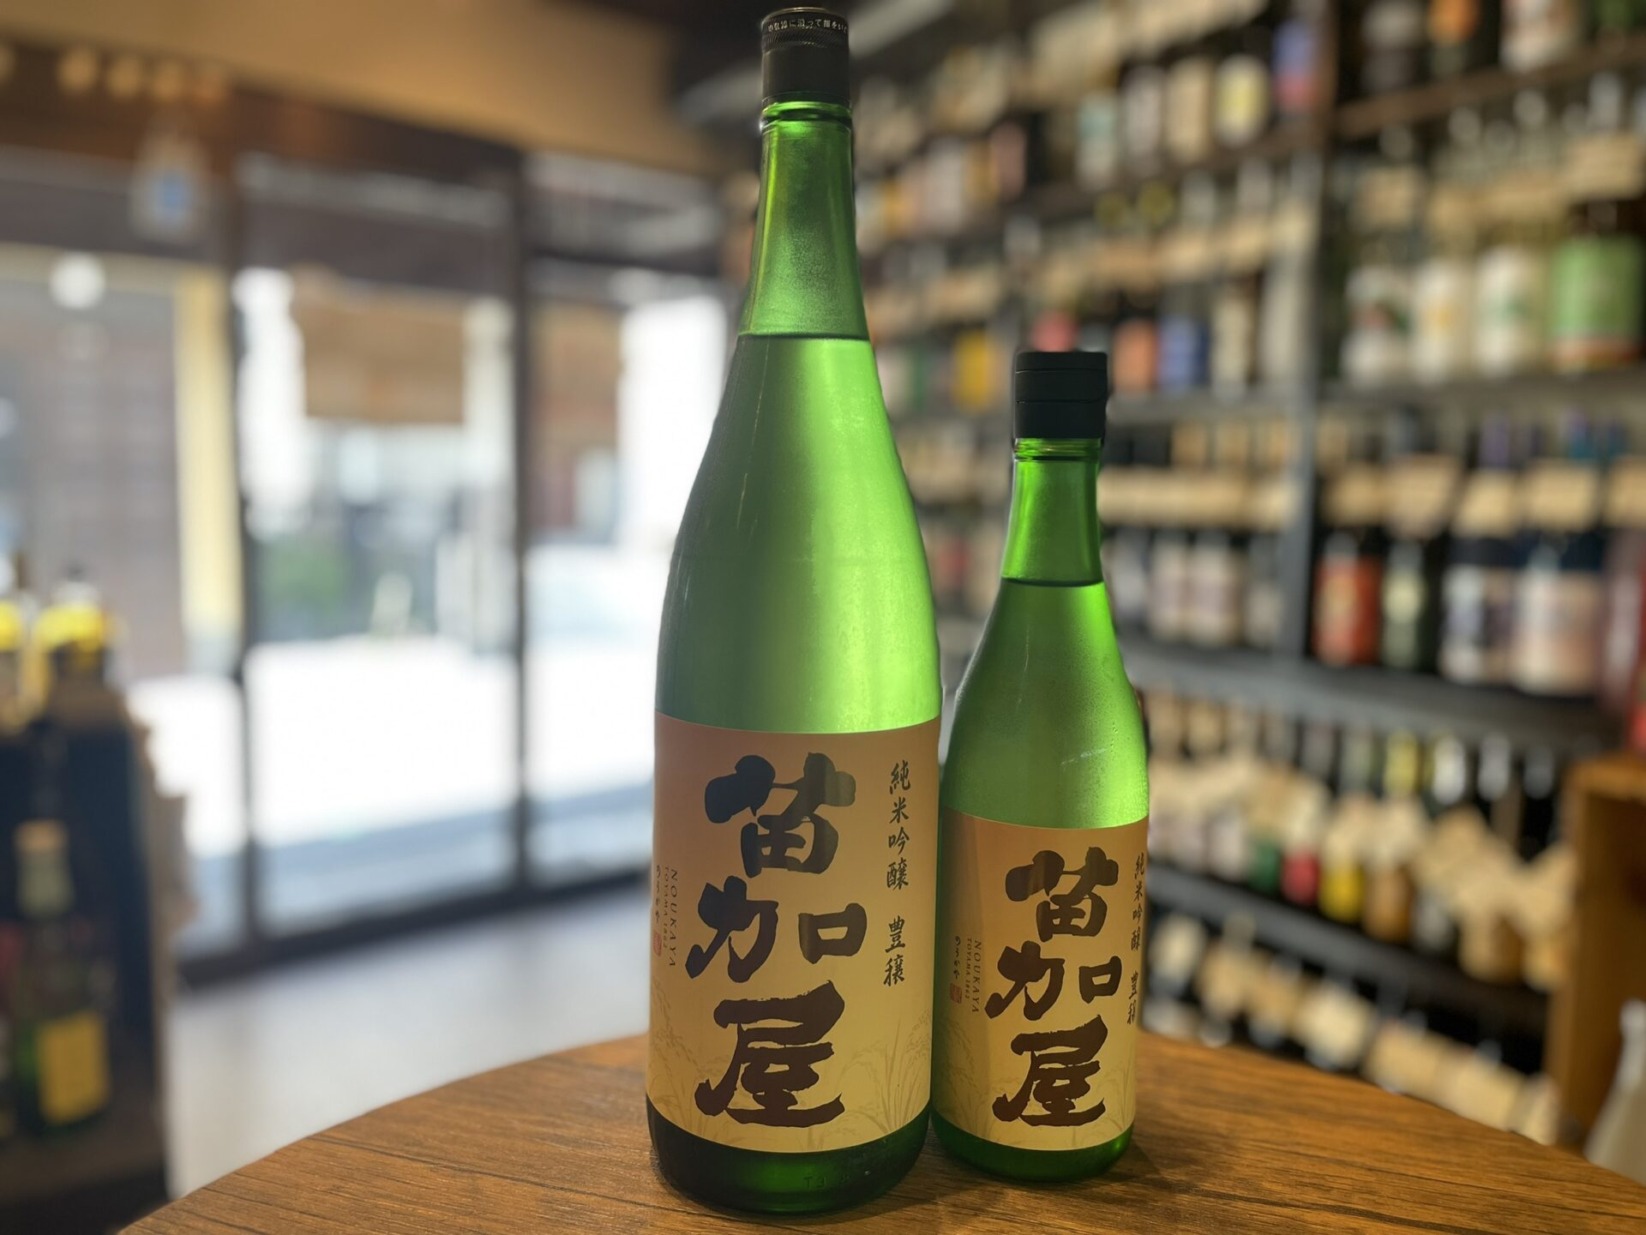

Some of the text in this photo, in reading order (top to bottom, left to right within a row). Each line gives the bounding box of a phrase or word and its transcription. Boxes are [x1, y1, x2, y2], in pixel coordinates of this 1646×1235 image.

[886, 759, 911, 890] 純米吟醸
[669, 868, 678, 967] NOUKAYA
[685, 752, 867, 1127] 苗加屋
[972, 940, 981, 1012] NOUKAYA
[985, 846, 1123, 1127] 苗加屋
